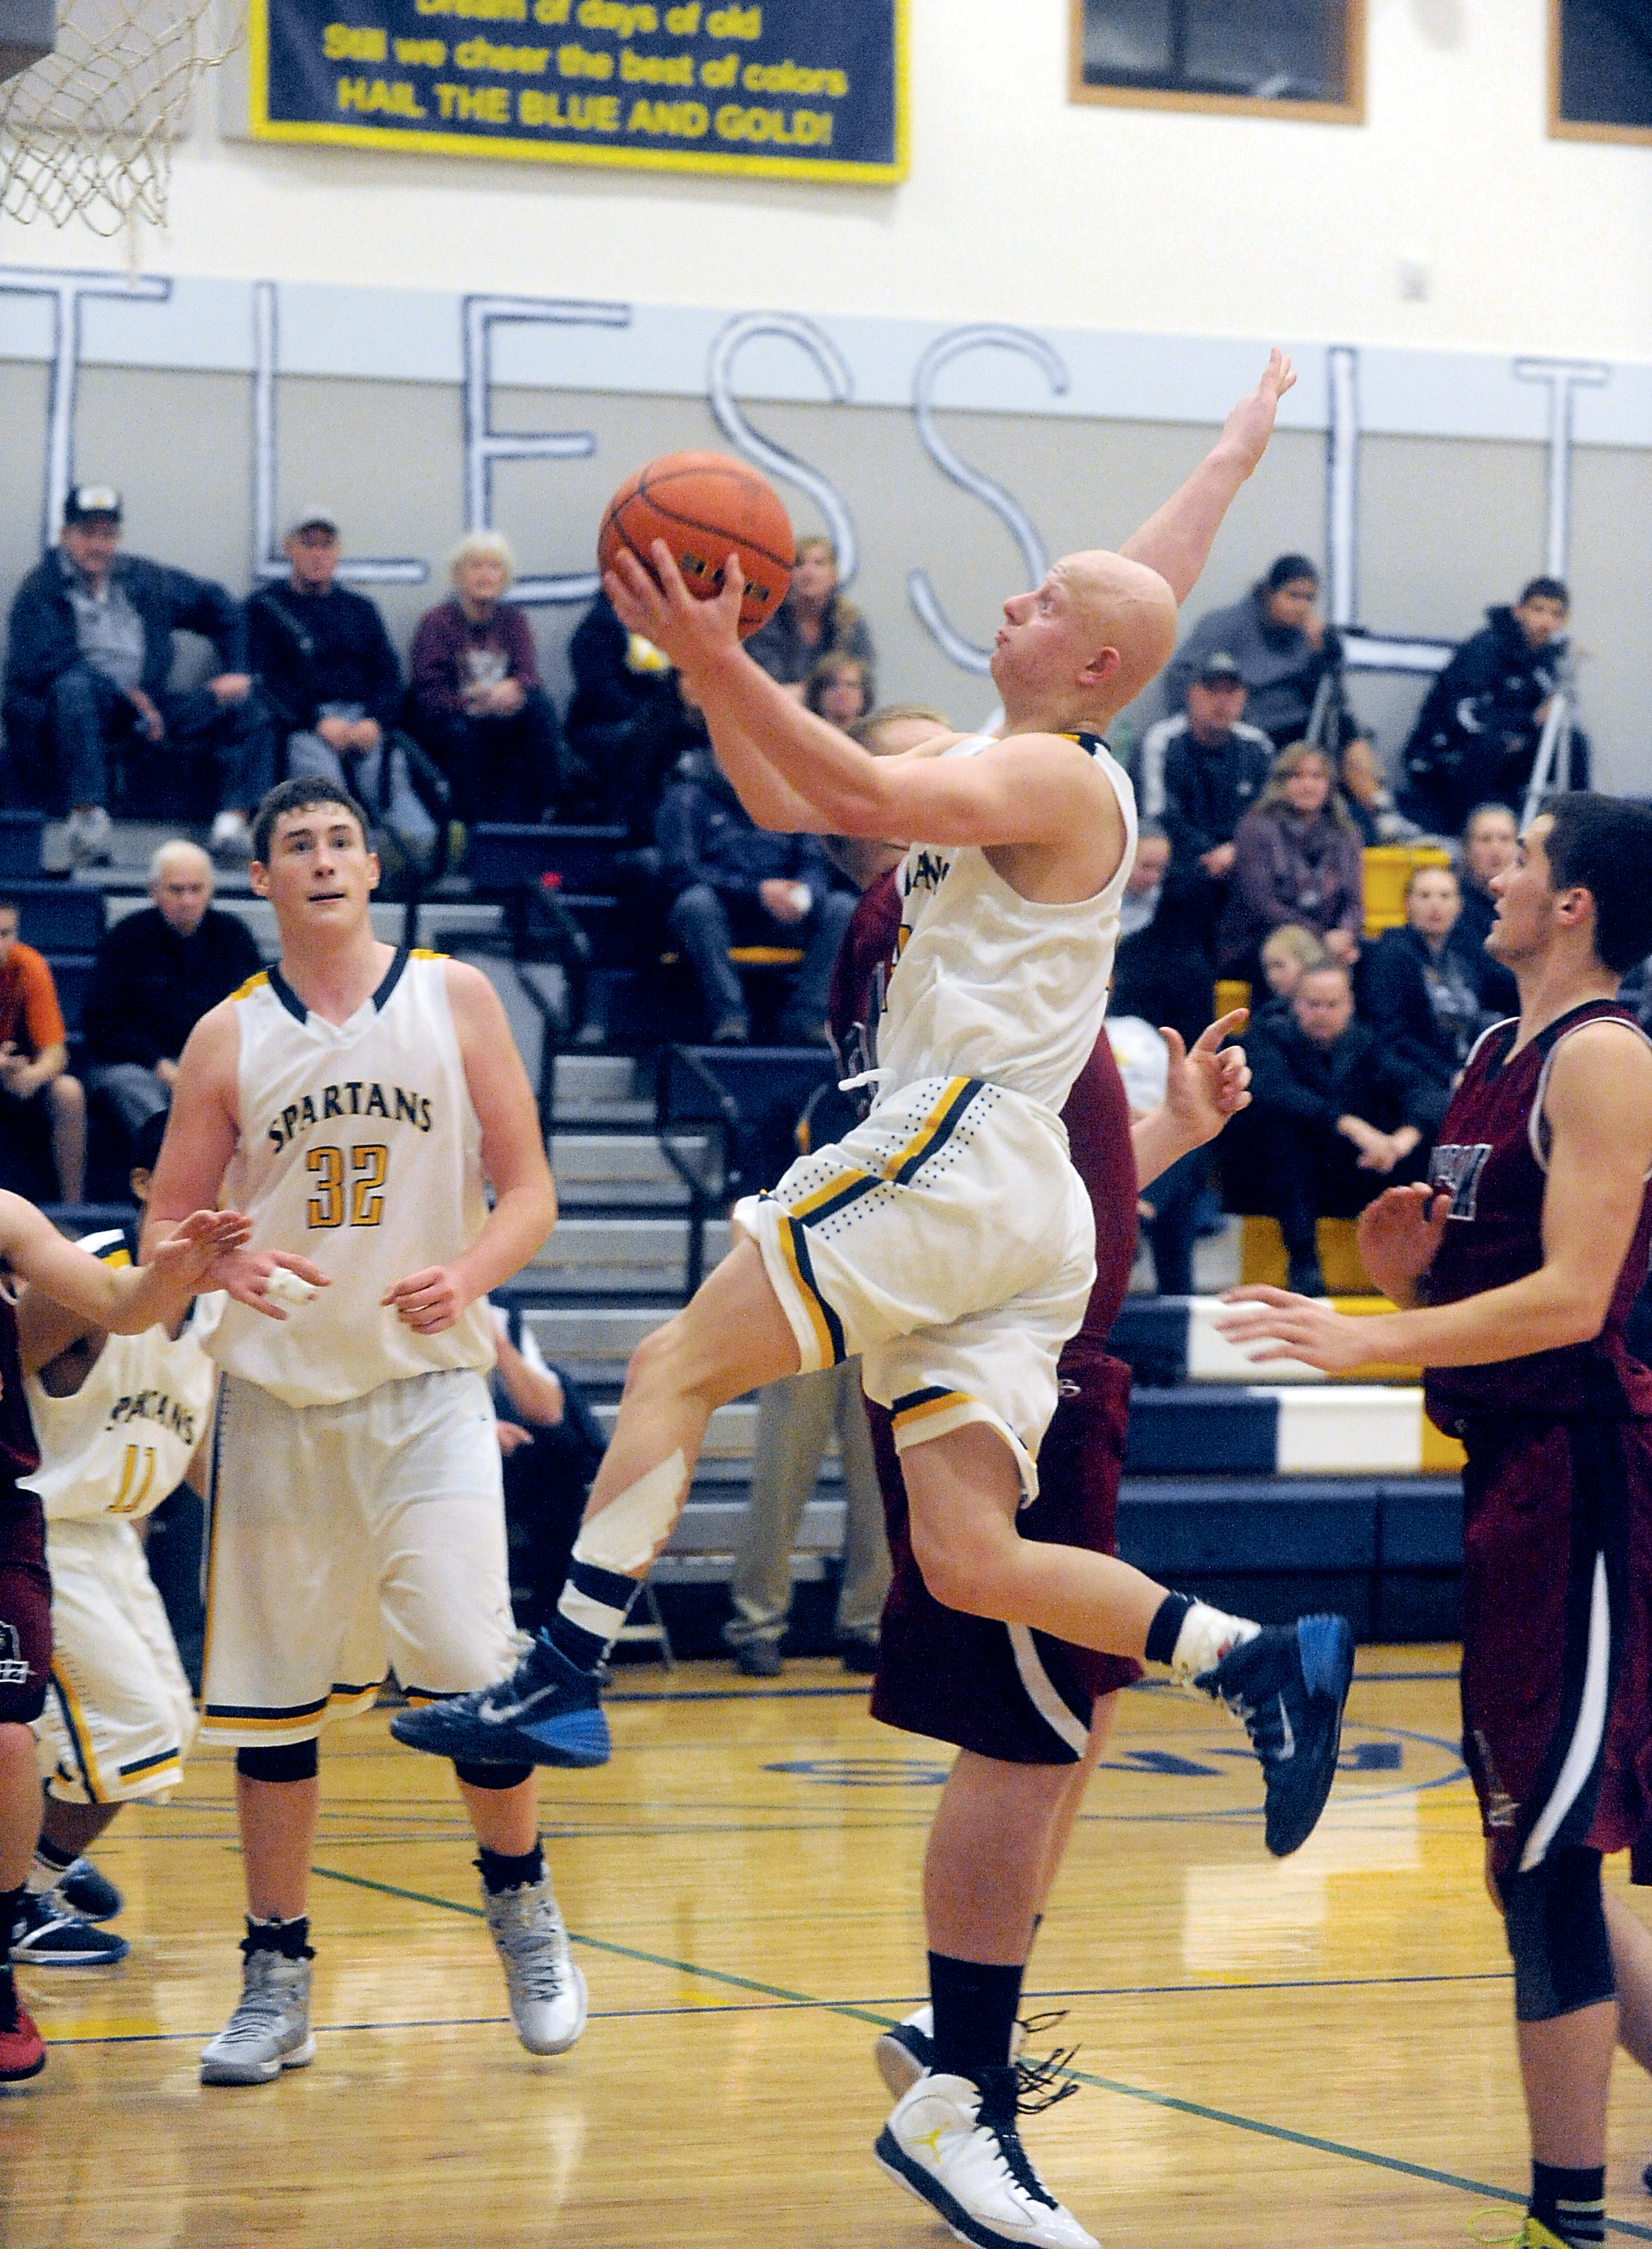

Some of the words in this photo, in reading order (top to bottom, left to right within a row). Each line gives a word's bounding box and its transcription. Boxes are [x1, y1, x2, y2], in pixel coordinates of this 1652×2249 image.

[577, 0, 657, 38] days
[666, 1, 700, 35] of
[706, 5, 762, 40] old
[324, 23, 387, 62] Still
[394, 37, 447, 68] we
[453, 37, 550, 75] cheer
[558, 43, 612, 80] the
[620, 47, 694, 88] best
[701, 53, 739, 88] of
[743, 58, 848, 97] colors
[435, 84, 509, 123] THE
[520, 89, 620, 132] BLUE
[628, 98, 708, 138] AND
[715, 104, 833, 145] GOLD!
[268, 1082, 432, 1153] SPARTANS
[307, 1143, 388, 1229] 32
[107, 1444, 155, 1512] 11
